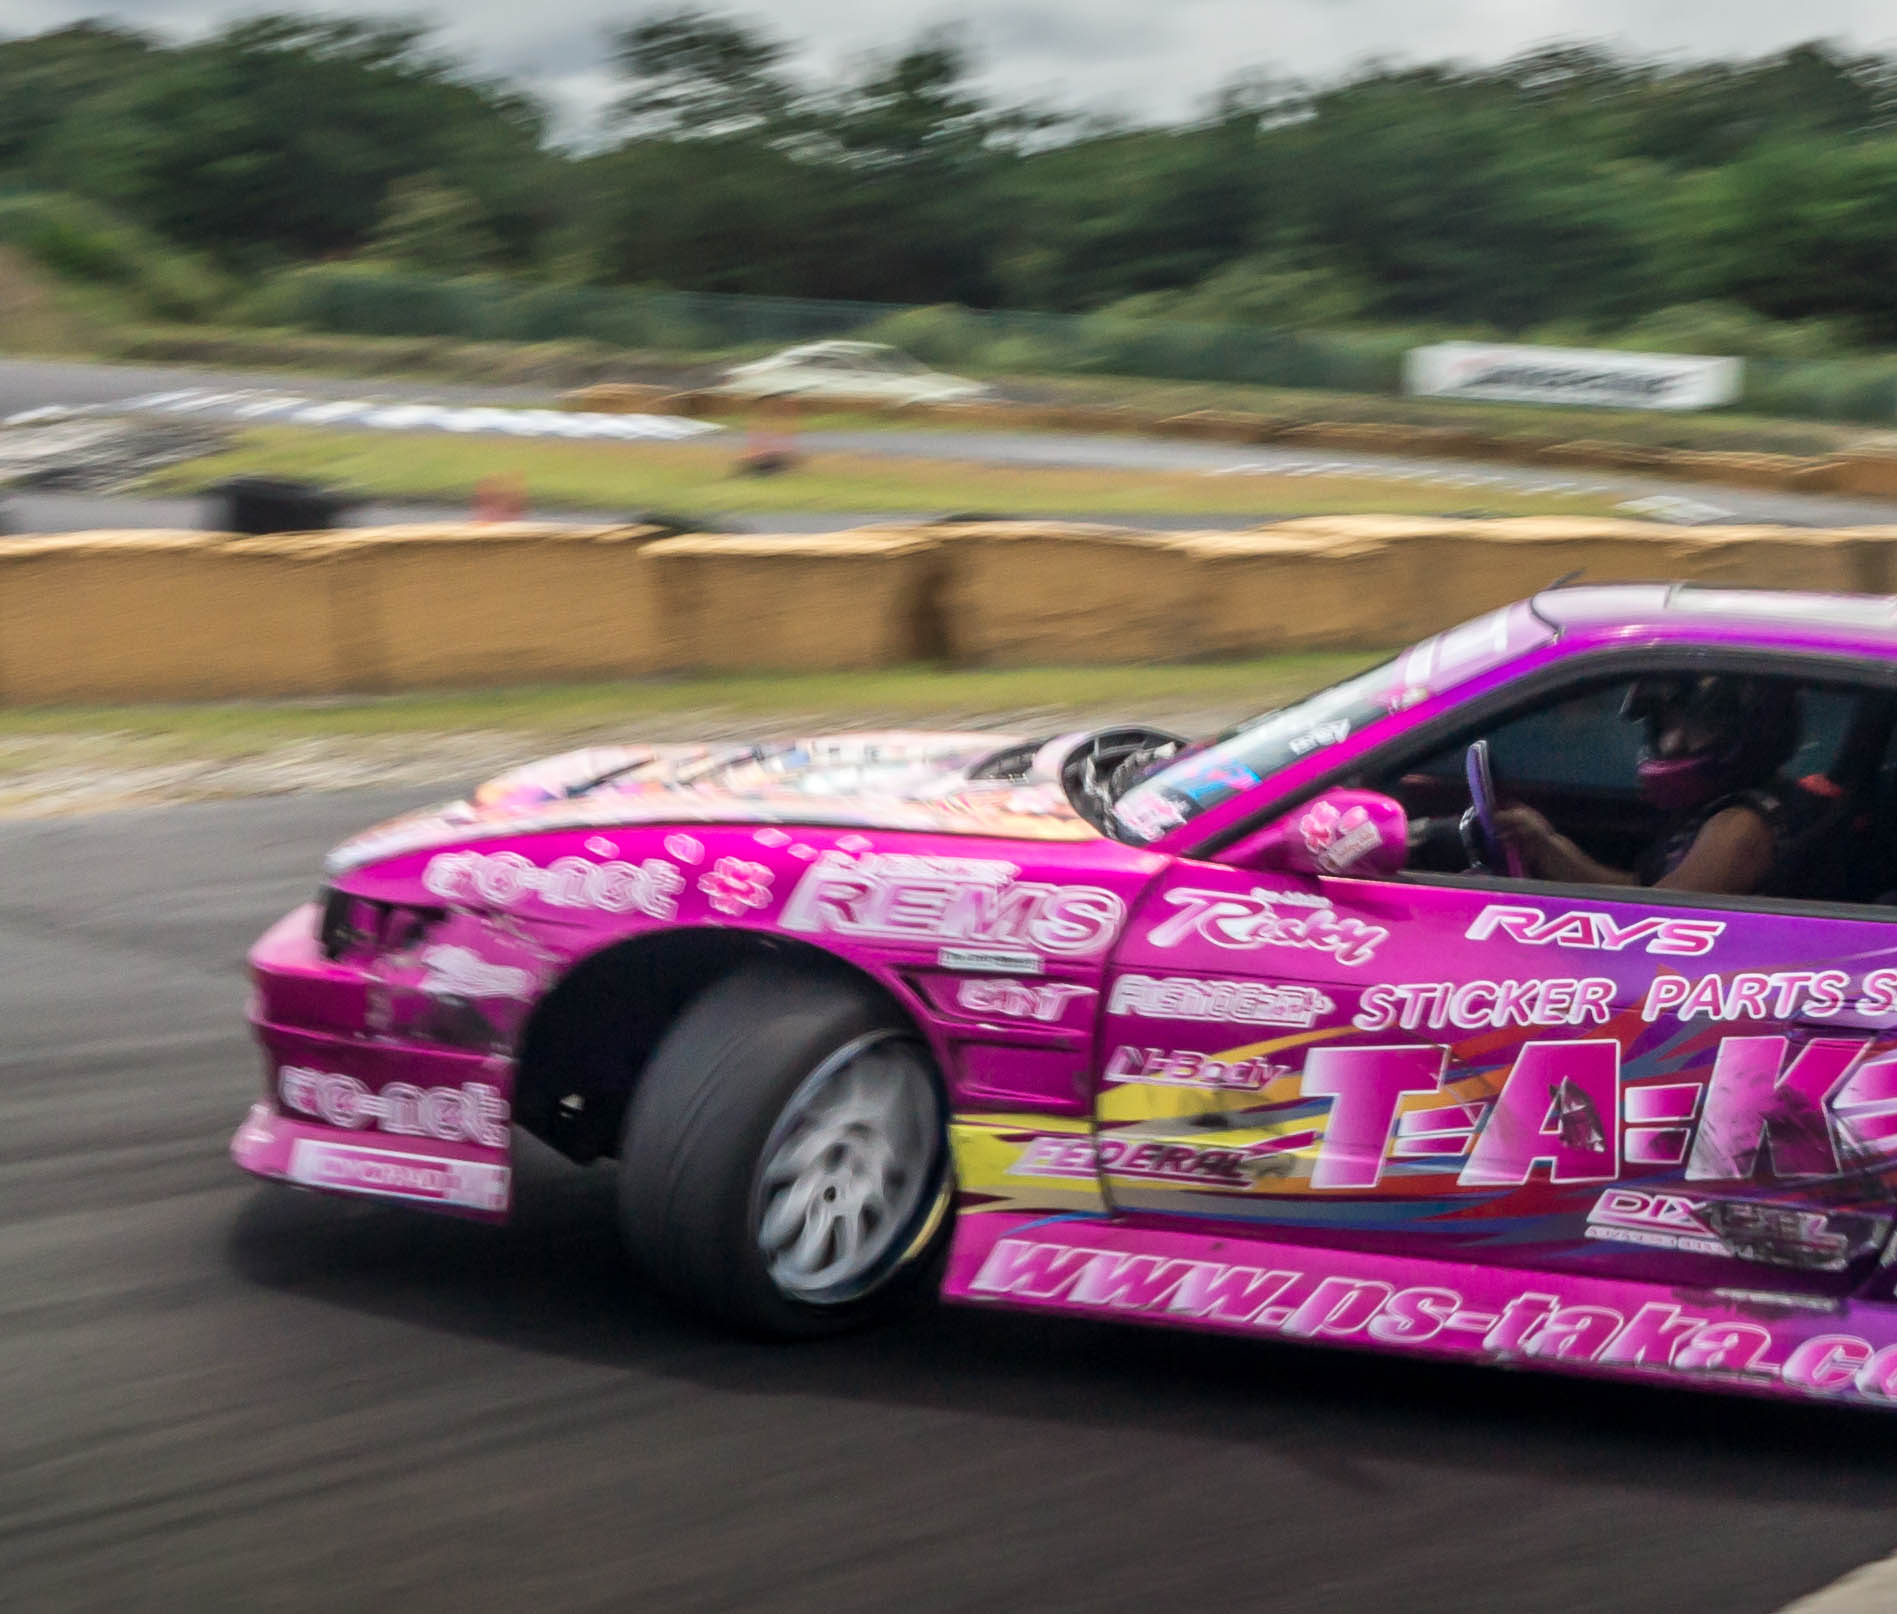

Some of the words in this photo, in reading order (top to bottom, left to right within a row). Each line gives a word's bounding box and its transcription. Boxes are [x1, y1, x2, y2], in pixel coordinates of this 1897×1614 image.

[778, 868, 1126, 956] REMS
[1465, 905, 1727, 955] RAYS
[1353, 977, 1617, 1030] STICKER
[1641, 969, 1849, 1024] PARTS
[1004, 1136, 1252, 1189] FEDERAL
